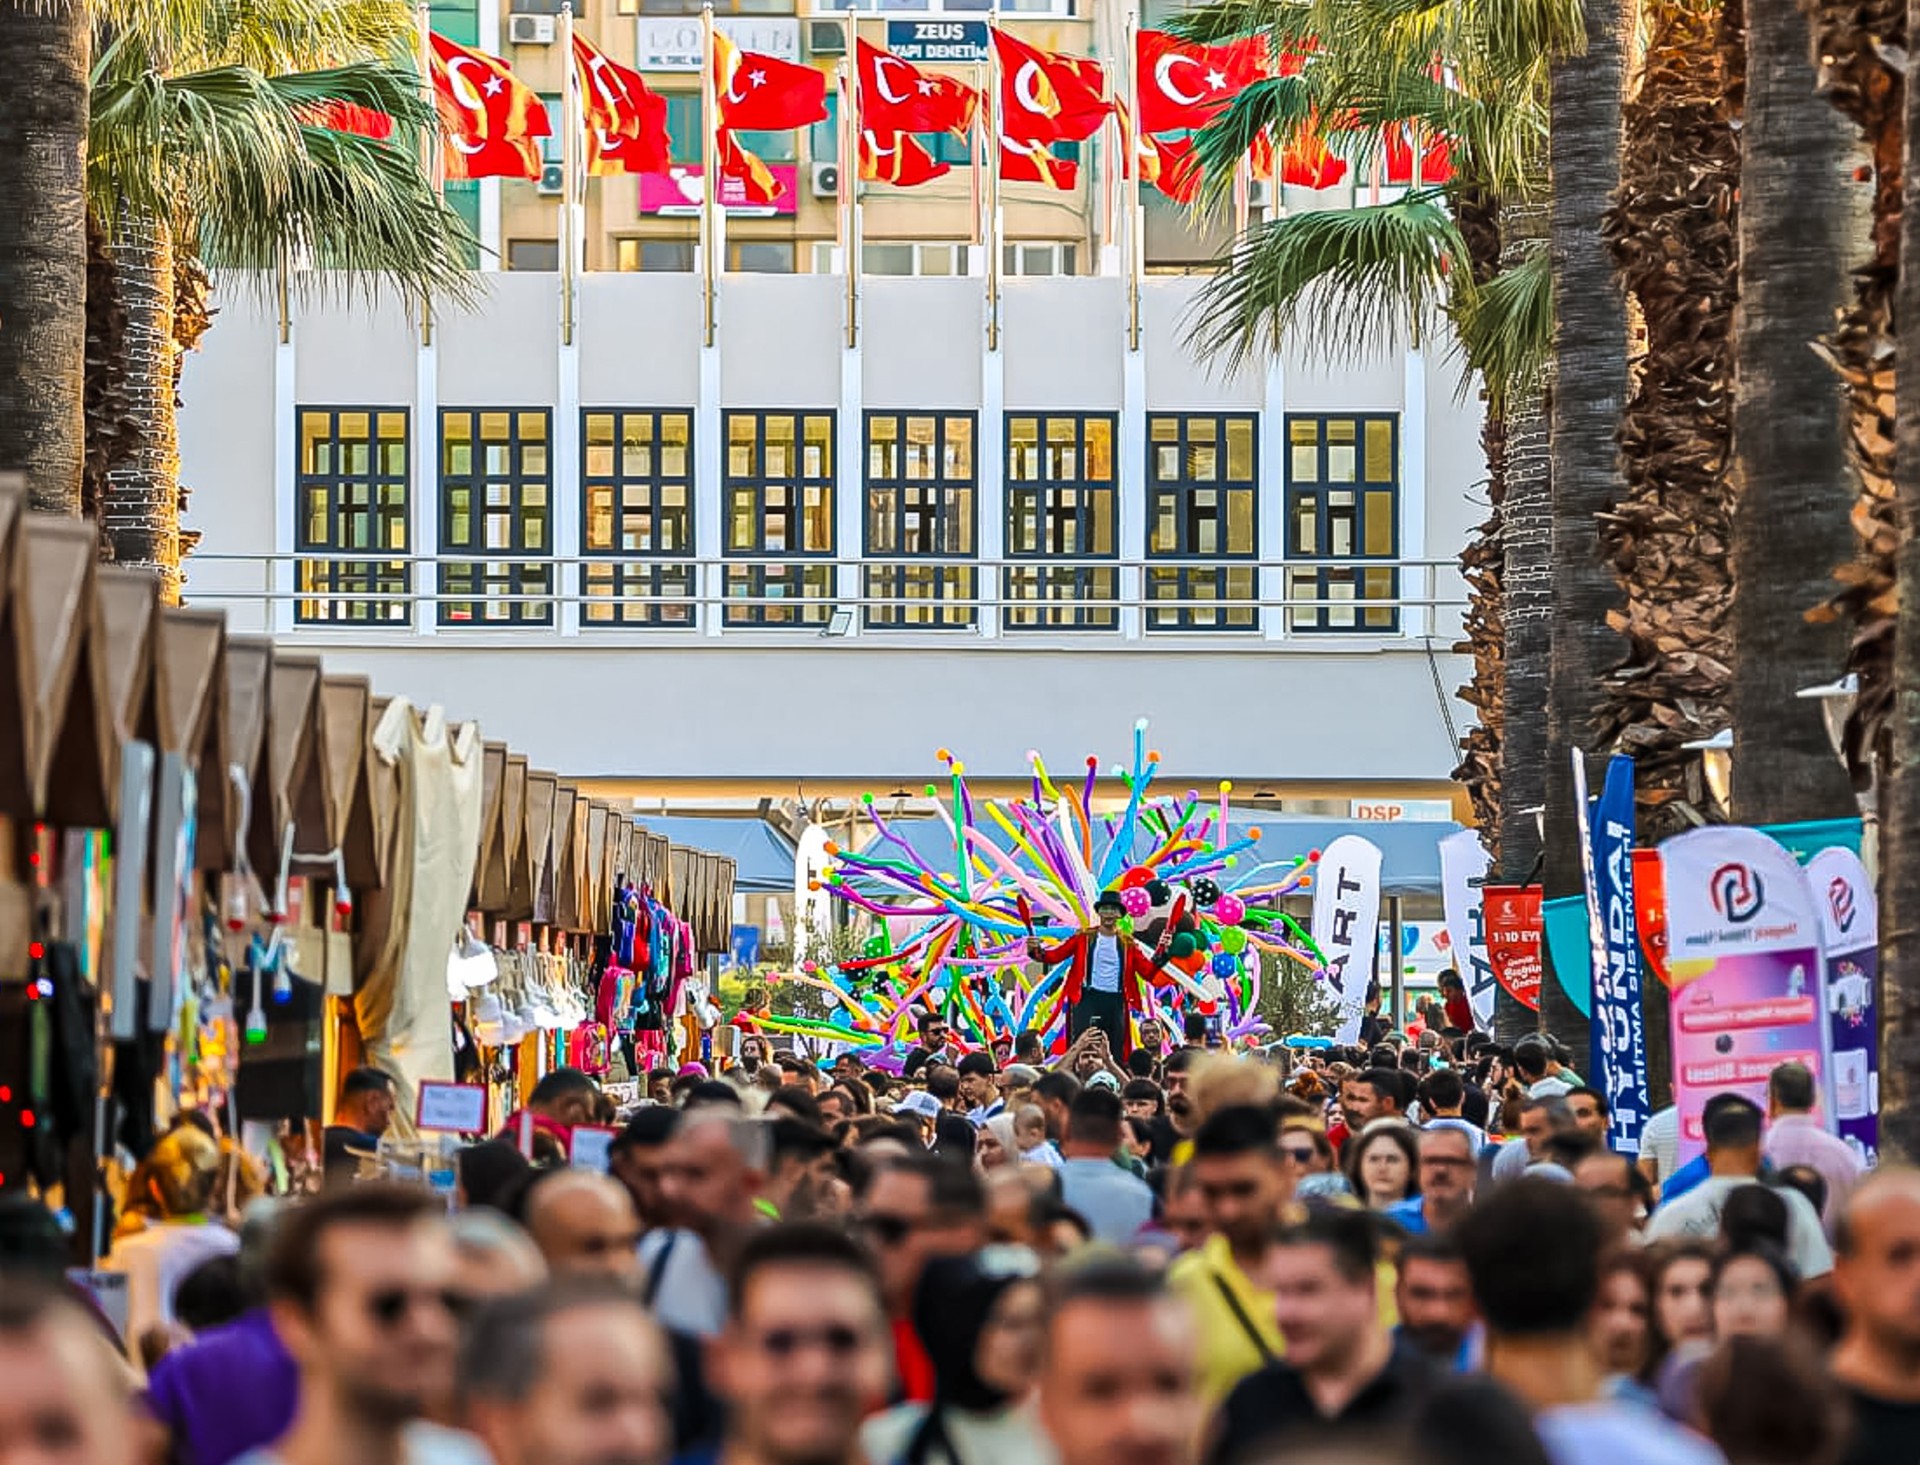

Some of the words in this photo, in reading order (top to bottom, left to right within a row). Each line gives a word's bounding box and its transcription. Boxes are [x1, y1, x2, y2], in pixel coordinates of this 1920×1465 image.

[914, 24, 965, 40] ZEUS
[889, 44, 922, 58] YAPI
[925, 41, 988, 58] DENETİM
[1358, 804, 1402, 821] DSP
[1327, 866, 1361, 1000] ART
[1607, 820, 1639, 1153] HYUNDAI
